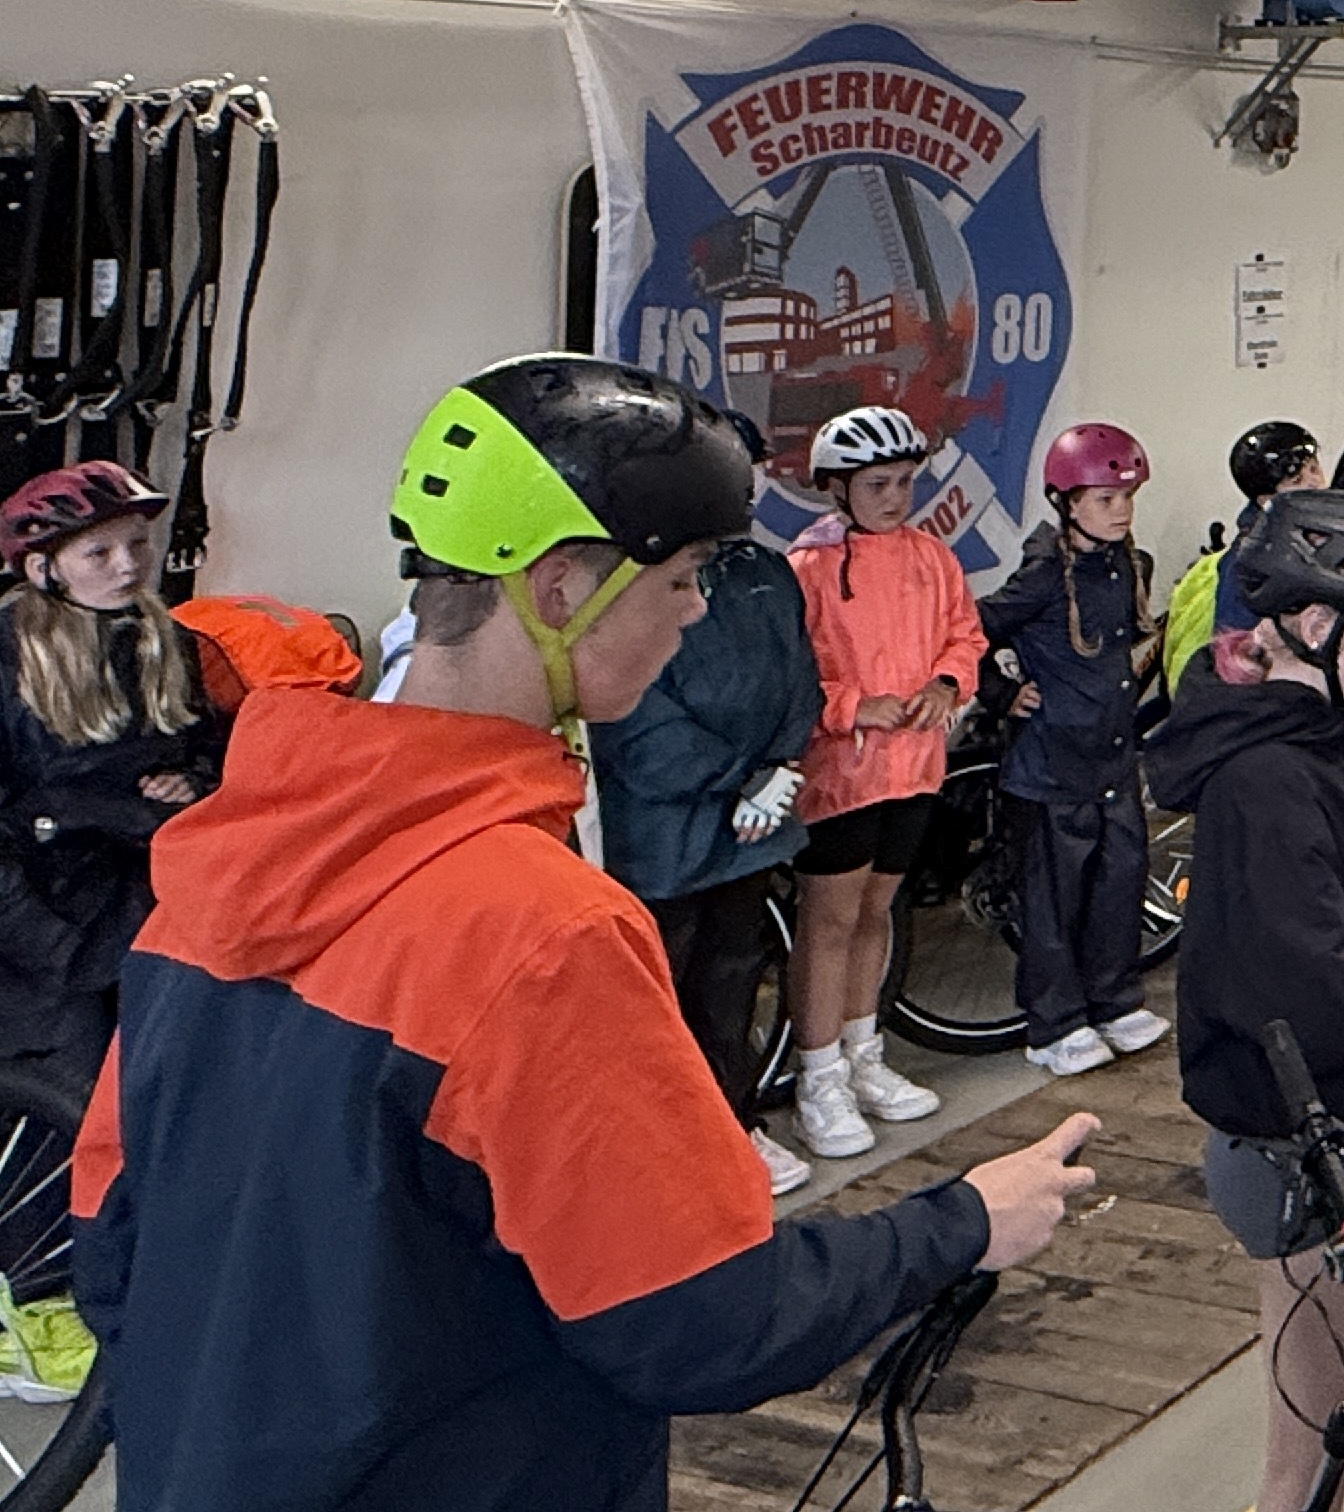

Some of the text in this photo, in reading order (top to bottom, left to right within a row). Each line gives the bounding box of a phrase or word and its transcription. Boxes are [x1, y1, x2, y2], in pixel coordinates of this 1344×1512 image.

[706, 70, 1005, 164] FEUERWEHR
[749, 115, 971, 183] Scharbeutz
[992, 292, 1053, 364] 80
